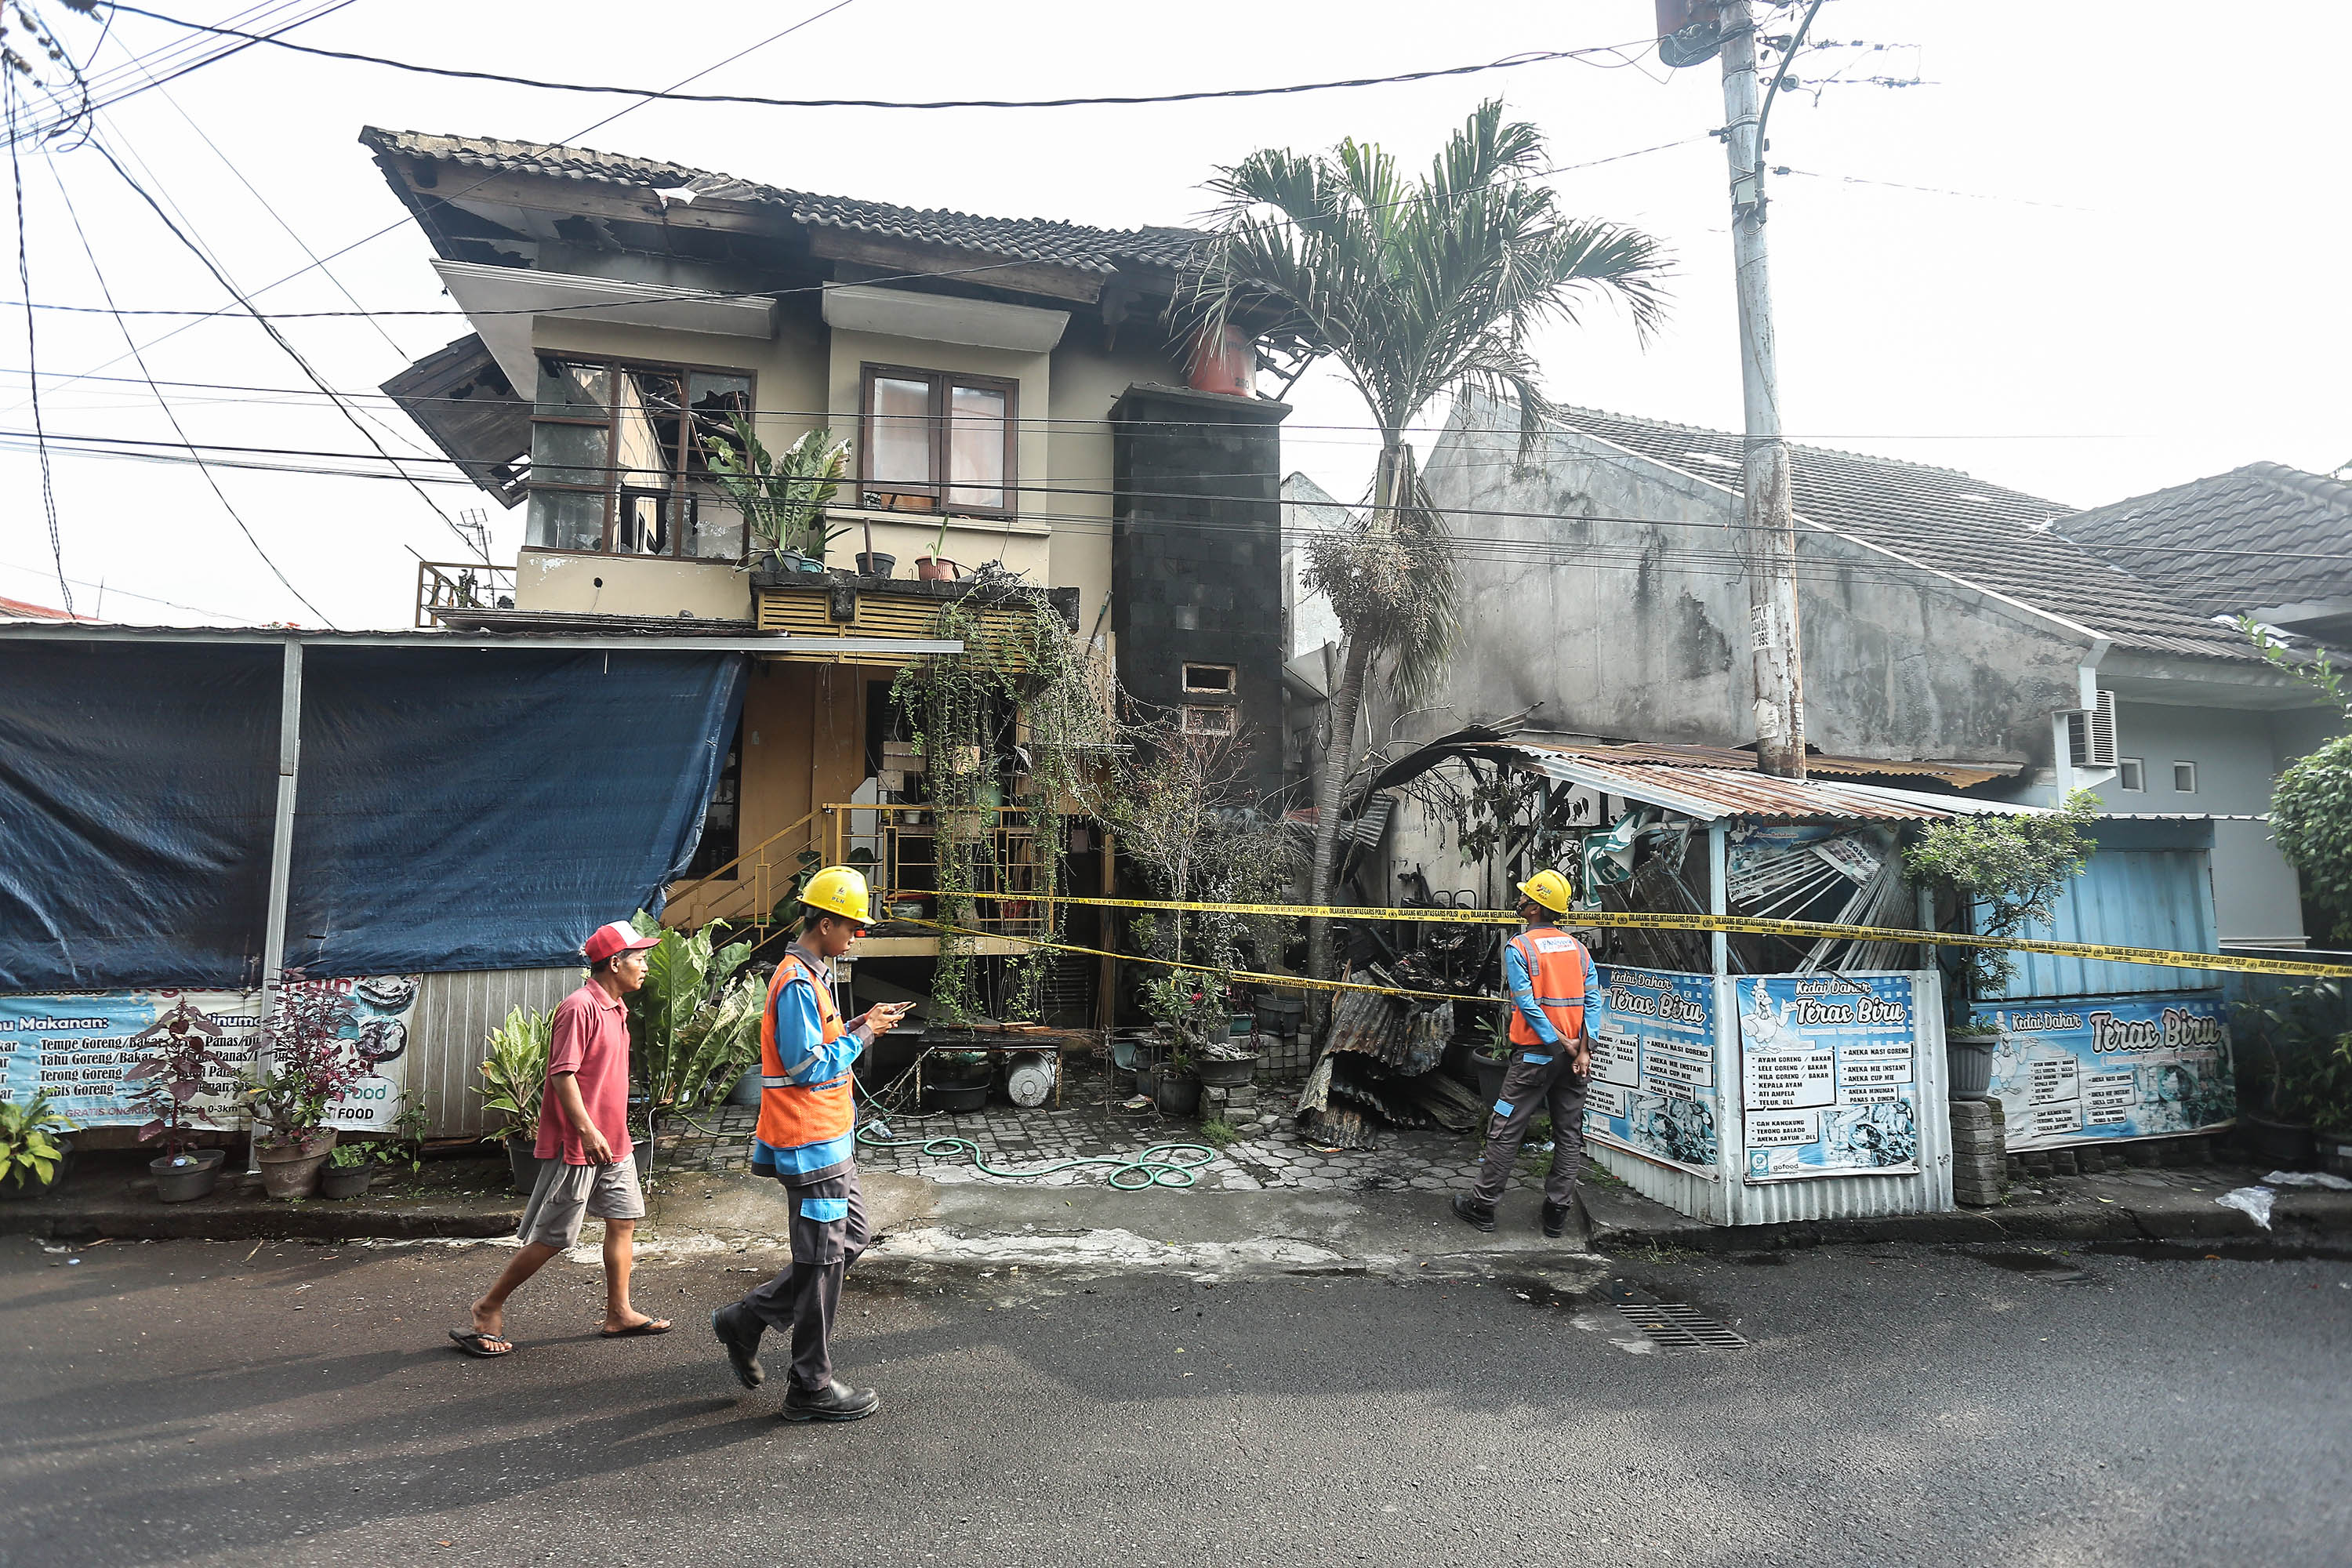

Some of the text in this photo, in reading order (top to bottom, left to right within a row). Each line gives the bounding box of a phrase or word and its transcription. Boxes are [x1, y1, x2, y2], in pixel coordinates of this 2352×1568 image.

[1235, 377, 1249, 389] 250
[1610, 970, 1672, 991] Kedai Dahar
[1795, 980, 1872, 995] Kedai Dahar
[1610, 986, 1656, 1015] Teras
[1659, 992, 1706, 1024] Biru
[1796, 996, 1906, 1025] Teras Biru
[18, 1016, 109, 1031] Makanan:
[2011, 1011, 2083, 1032] Kedai Dahar
[2090, 1008, 2221, 1054] Teras Biru
[41, 1039, 78, 1051] Tempe
[1651, 1041, 1708, 1057] ANEKA NASI GORENG
[41, 1052, 154, 1066] Tahu Goreng/Bakar
[1650, 1056, 1667, 1065] ANEKA
[1680, 1063, 1703, 1073] INSTANT
[40, 1067, 122, 1082] Terong Goreng
[1650, 1066, 1668, 1075] ANEKA
[74, 1083, 114, 1096] Goreng
[1650, 1077, 1666, 1087] ANEKA
[65, 1108, 105, 1117] GRATIS
[338, 1108, 374, 1119] FOOD
[1773, 1164, 1799, 1172] gofood
